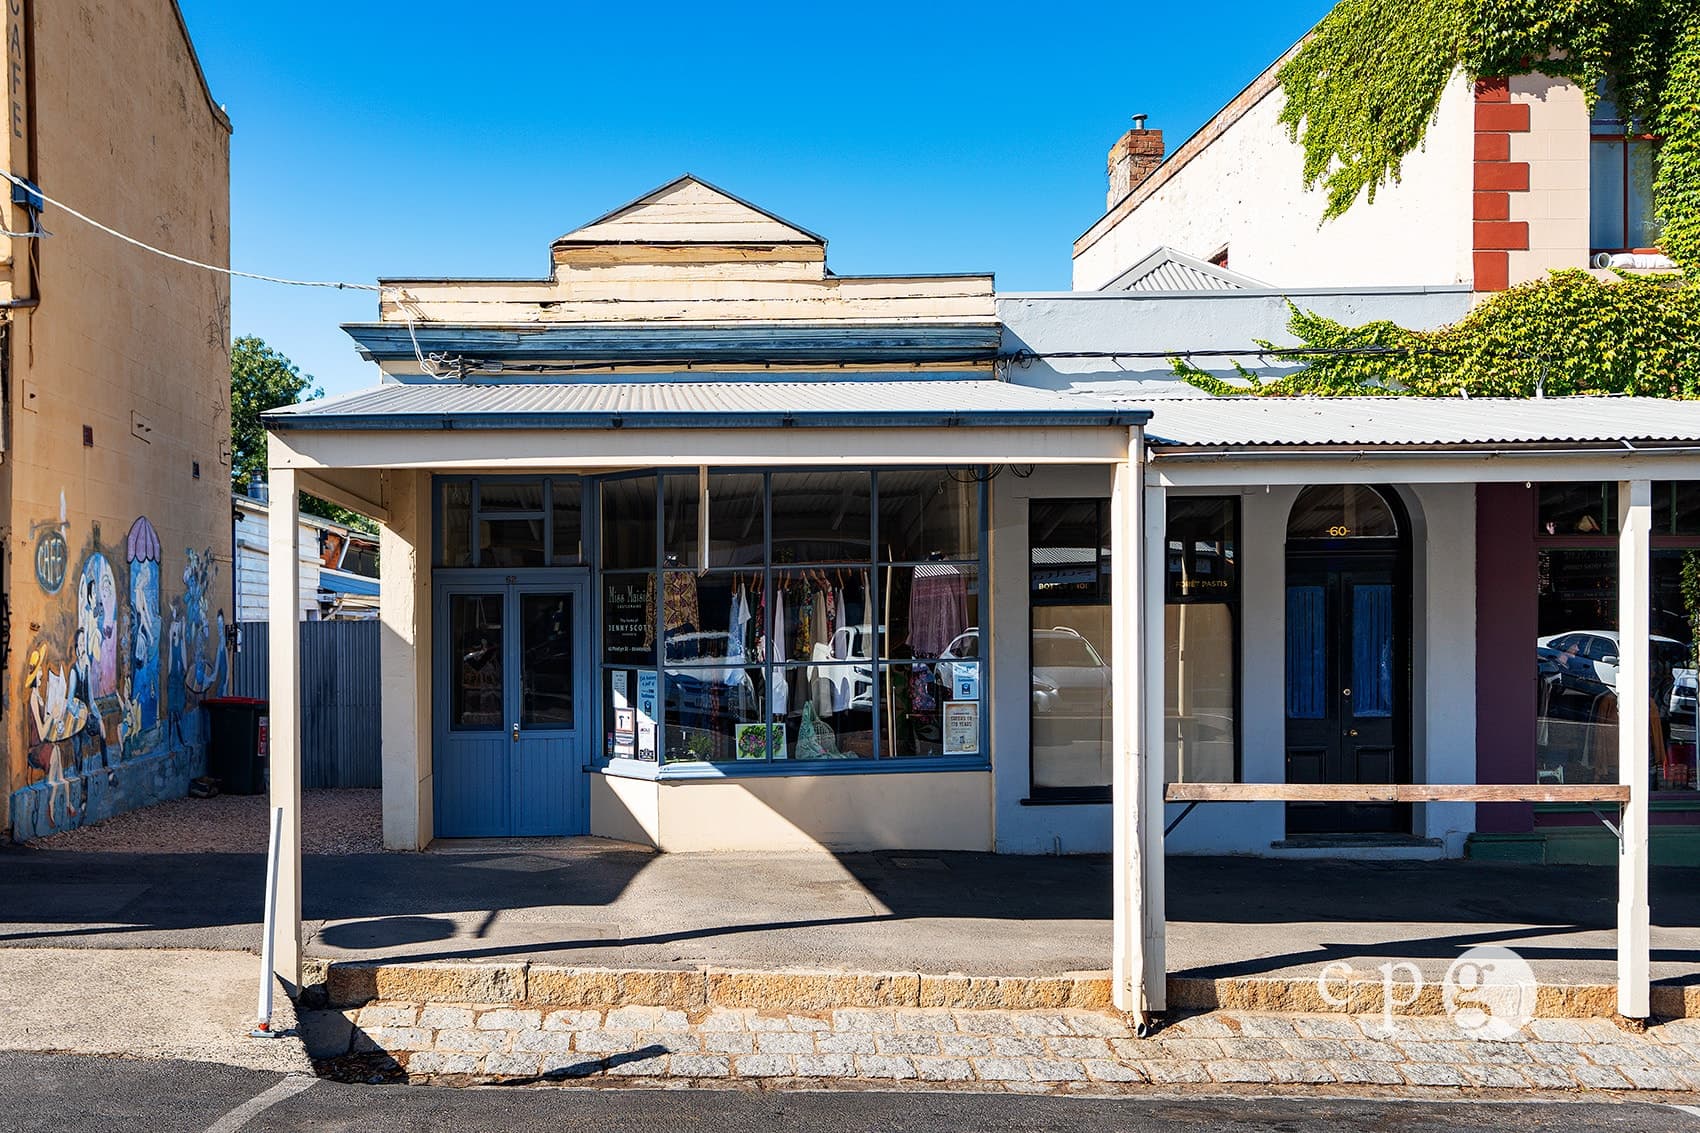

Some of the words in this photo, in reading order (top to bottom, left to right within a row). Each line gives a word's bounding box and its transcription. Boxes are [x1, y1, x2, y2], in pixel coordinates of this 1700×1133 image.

[38, 539, 61, 584] CAFE
[608, 585, 625, 603] Miss
[627, 585, 648, 603] Maisi
